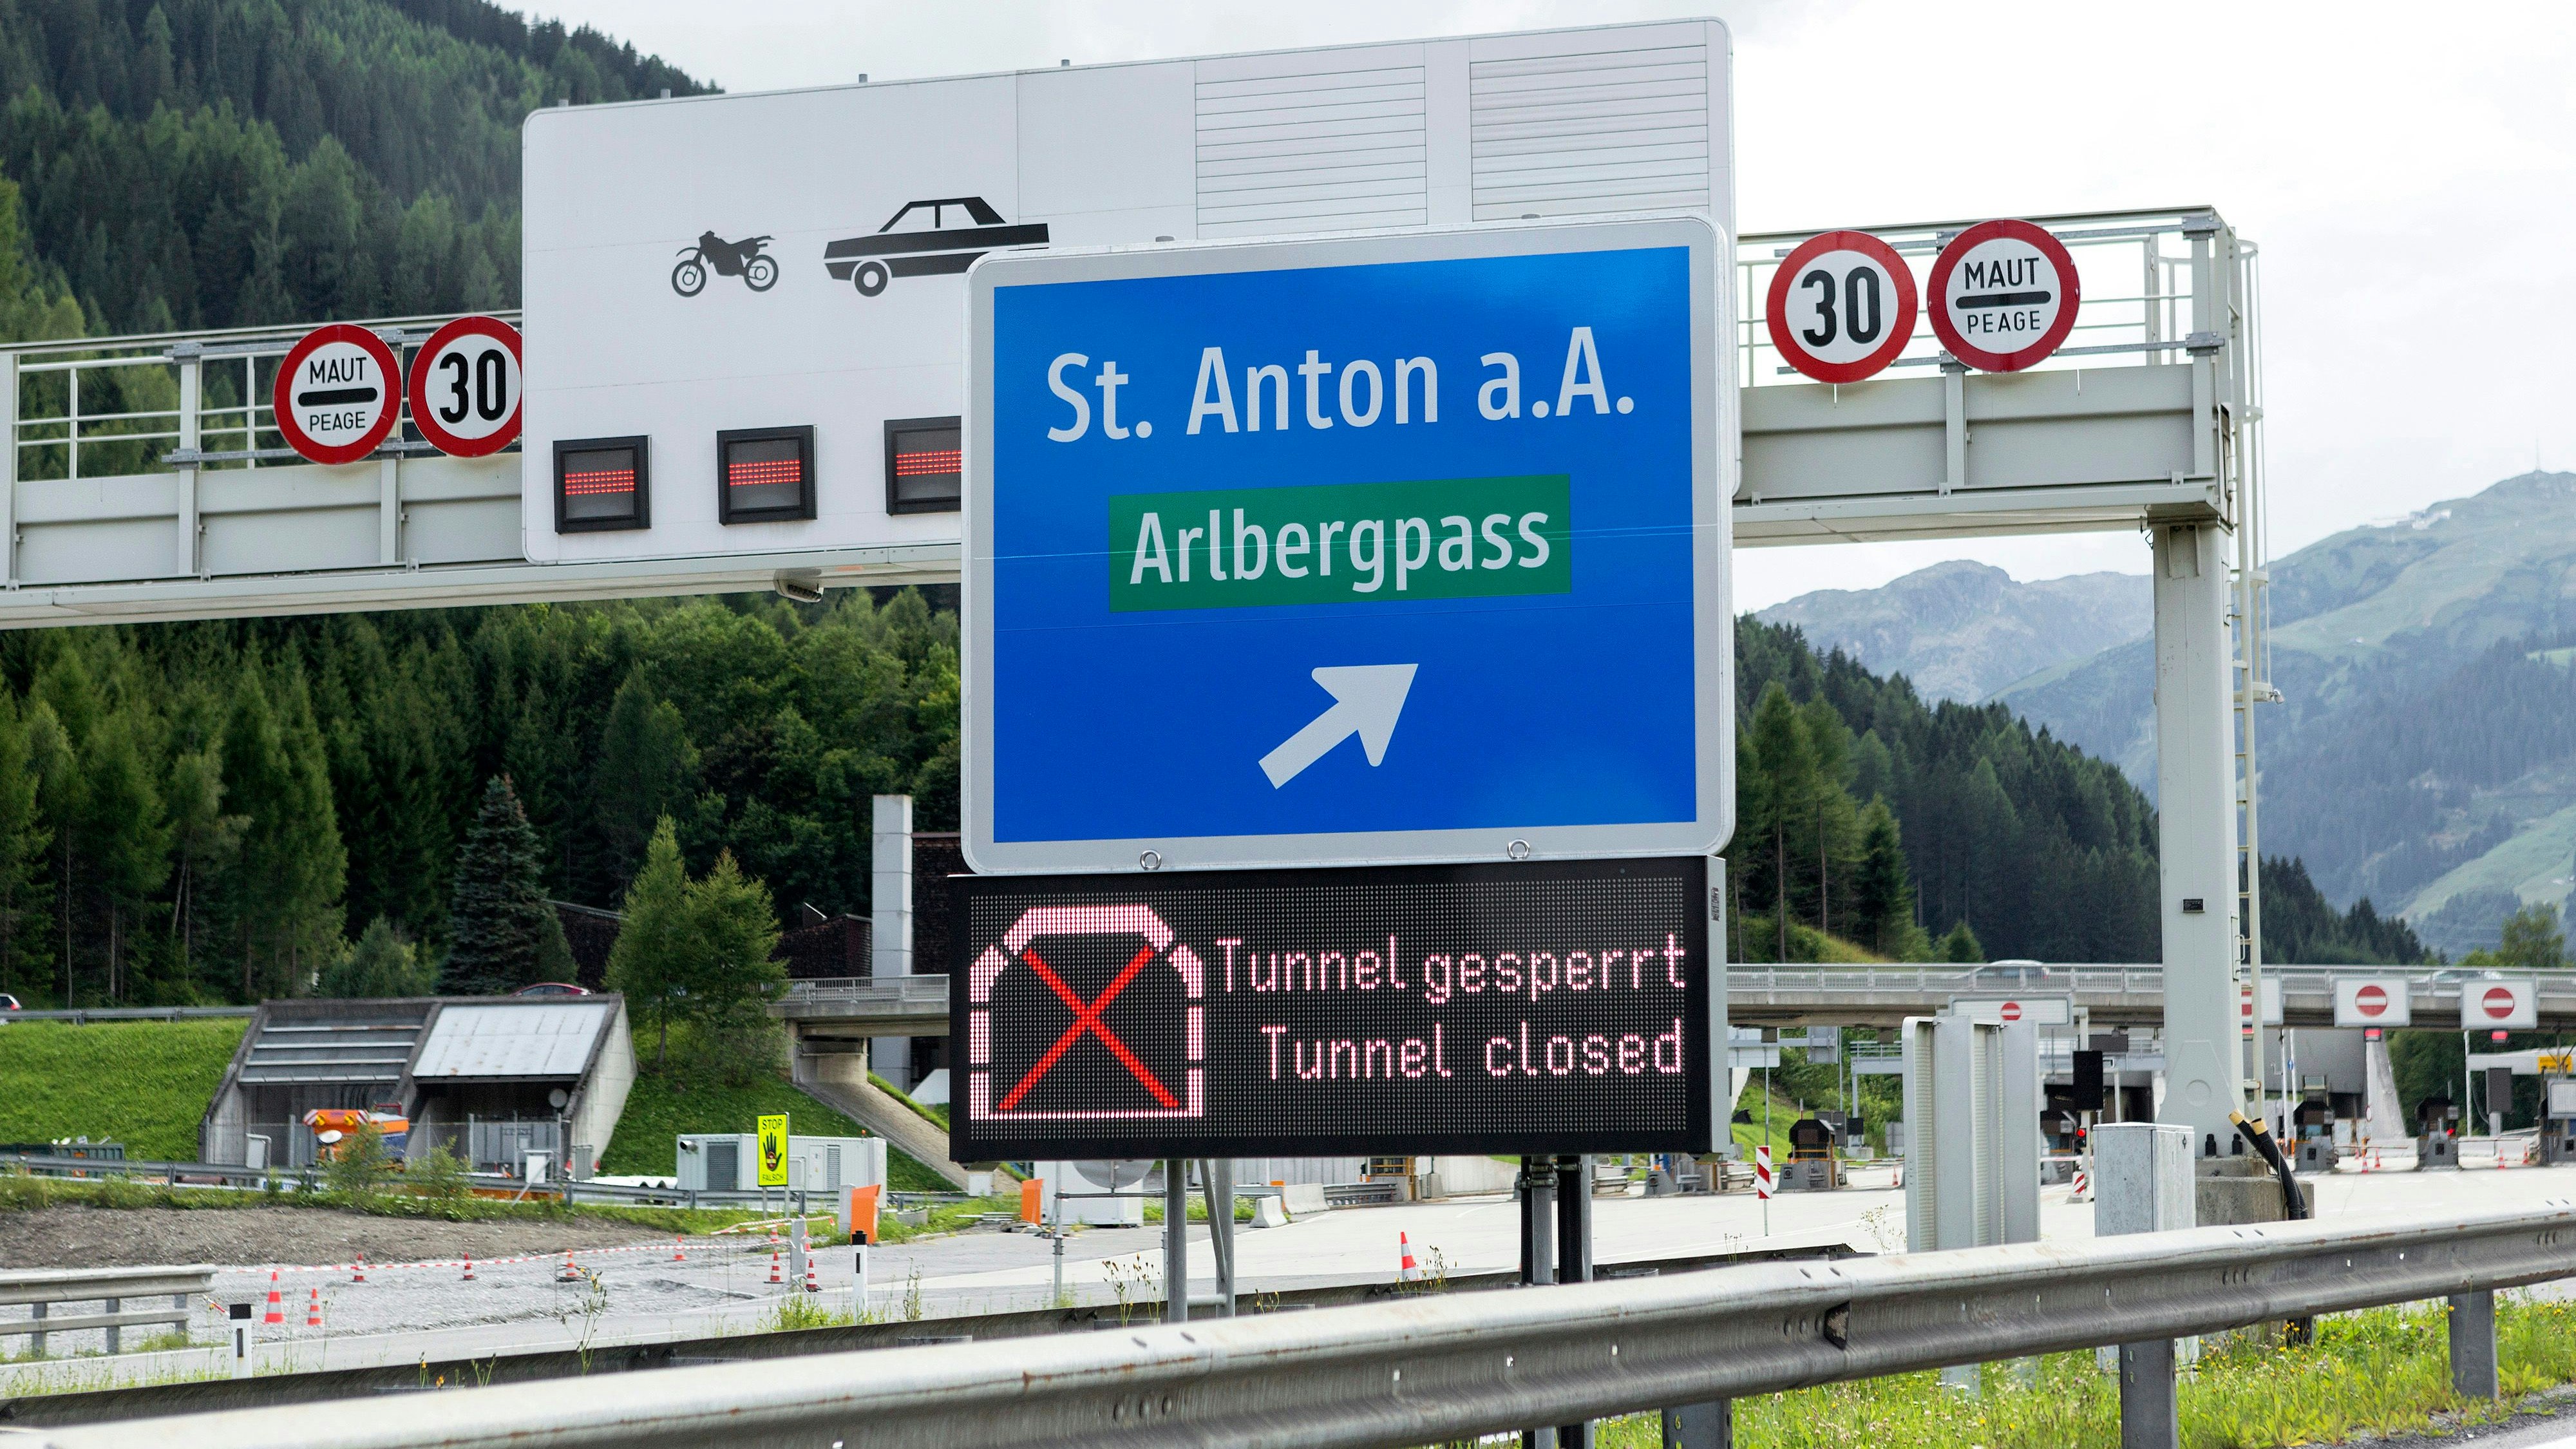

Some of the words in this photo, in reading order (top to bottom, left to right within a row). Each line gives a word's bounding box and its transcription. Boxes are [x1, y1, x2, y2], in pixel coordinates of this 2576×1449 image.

[1965, 258, 2039, 289] MAUT
[1802, 266, 1881, 348] 30
[1967, 311, 2040, 334] PEAGE
[310, 357, 366, 384] MAUT
[439, 348, 506, 424] 30
[1048, 353, 1151, 442] St.
[1187, 347, 1437, 434] Anton
[1479, 327, 1633, 420] a.A.
[310, 412, 365, 431] PEAGE
[1130, 509, 1549, 592] Arlbergpass
[1217, 936, 1405, 992] Tunnel
[1425, 934, 1685, 1004] gesperrt
[1262, 1023, 1451, 1079] Tunnel
[1486, 1018, 1680, 1076] closed
[762, 1119, 782, 1130] STOP
